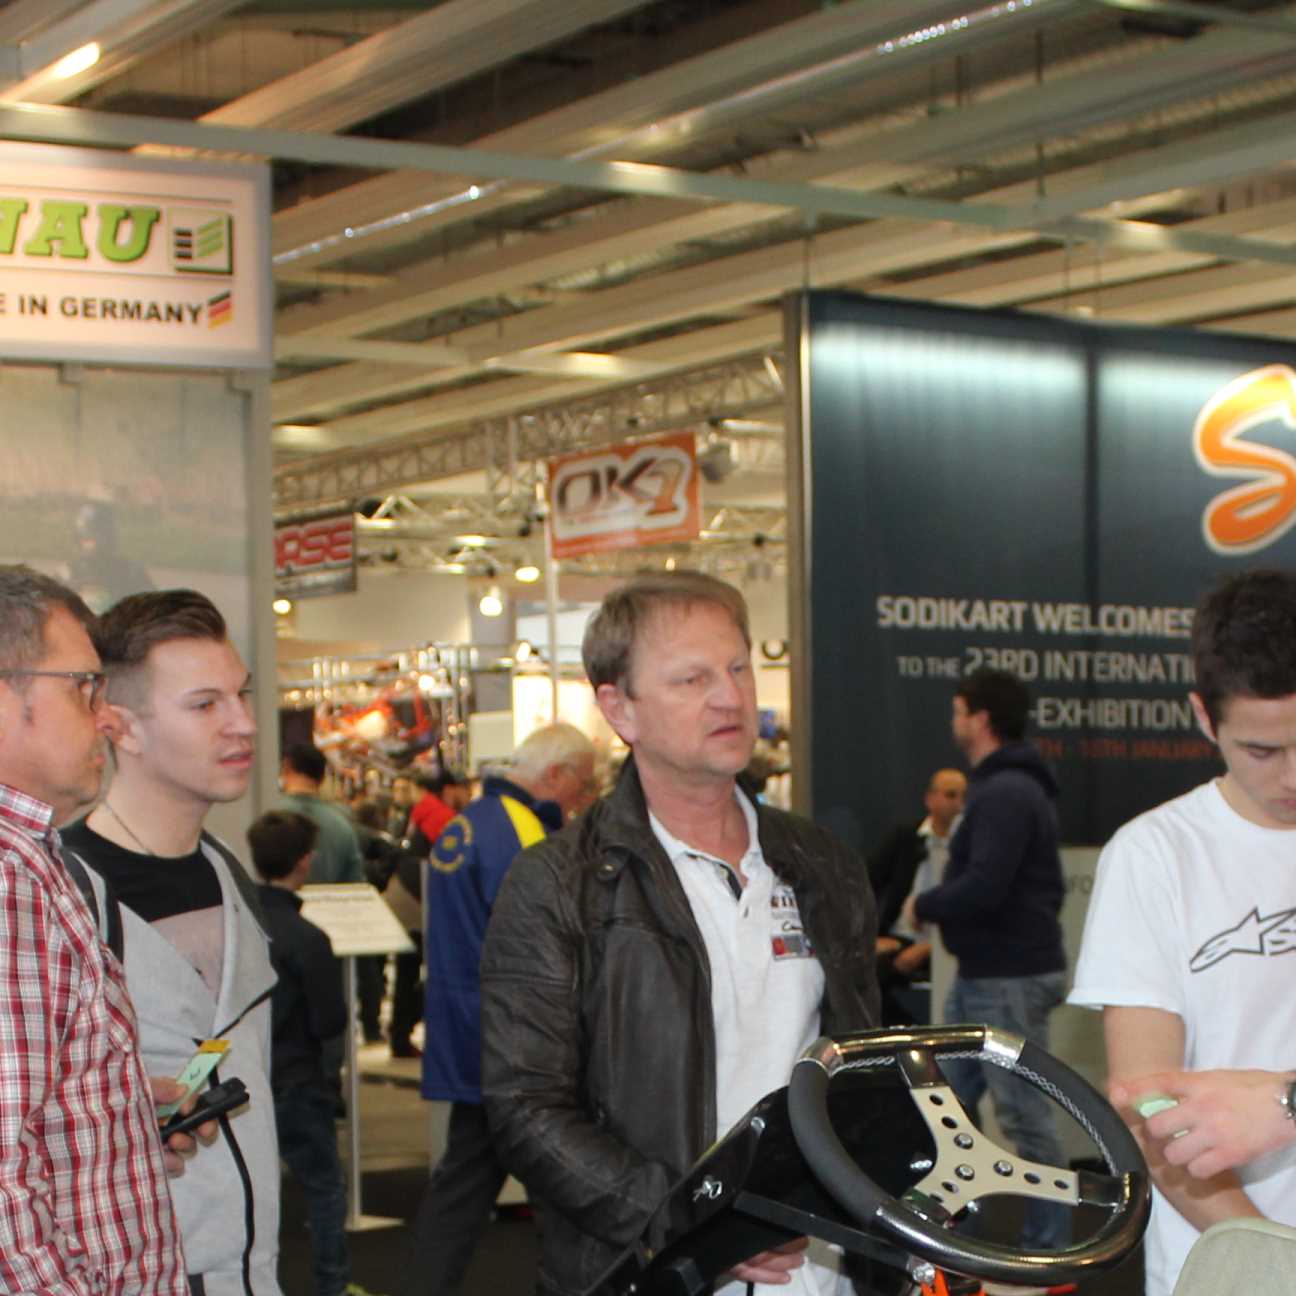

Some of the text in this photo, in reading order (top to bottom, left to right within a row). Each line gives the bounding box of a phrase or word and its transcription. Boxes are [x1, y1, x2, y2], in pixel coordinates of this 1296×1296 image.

[17, 294, 49, 316] IN
[59, 296, 203, 323] GERMANY
[272, 521, 353, 570] RSE
[876, 594, 1196, 638] SODIKART WELCOMES
[897, 655, 922, 677] TO
[927, 657, 959, 679] THE
[1045, 651, 1197, 684] INTERNATI
